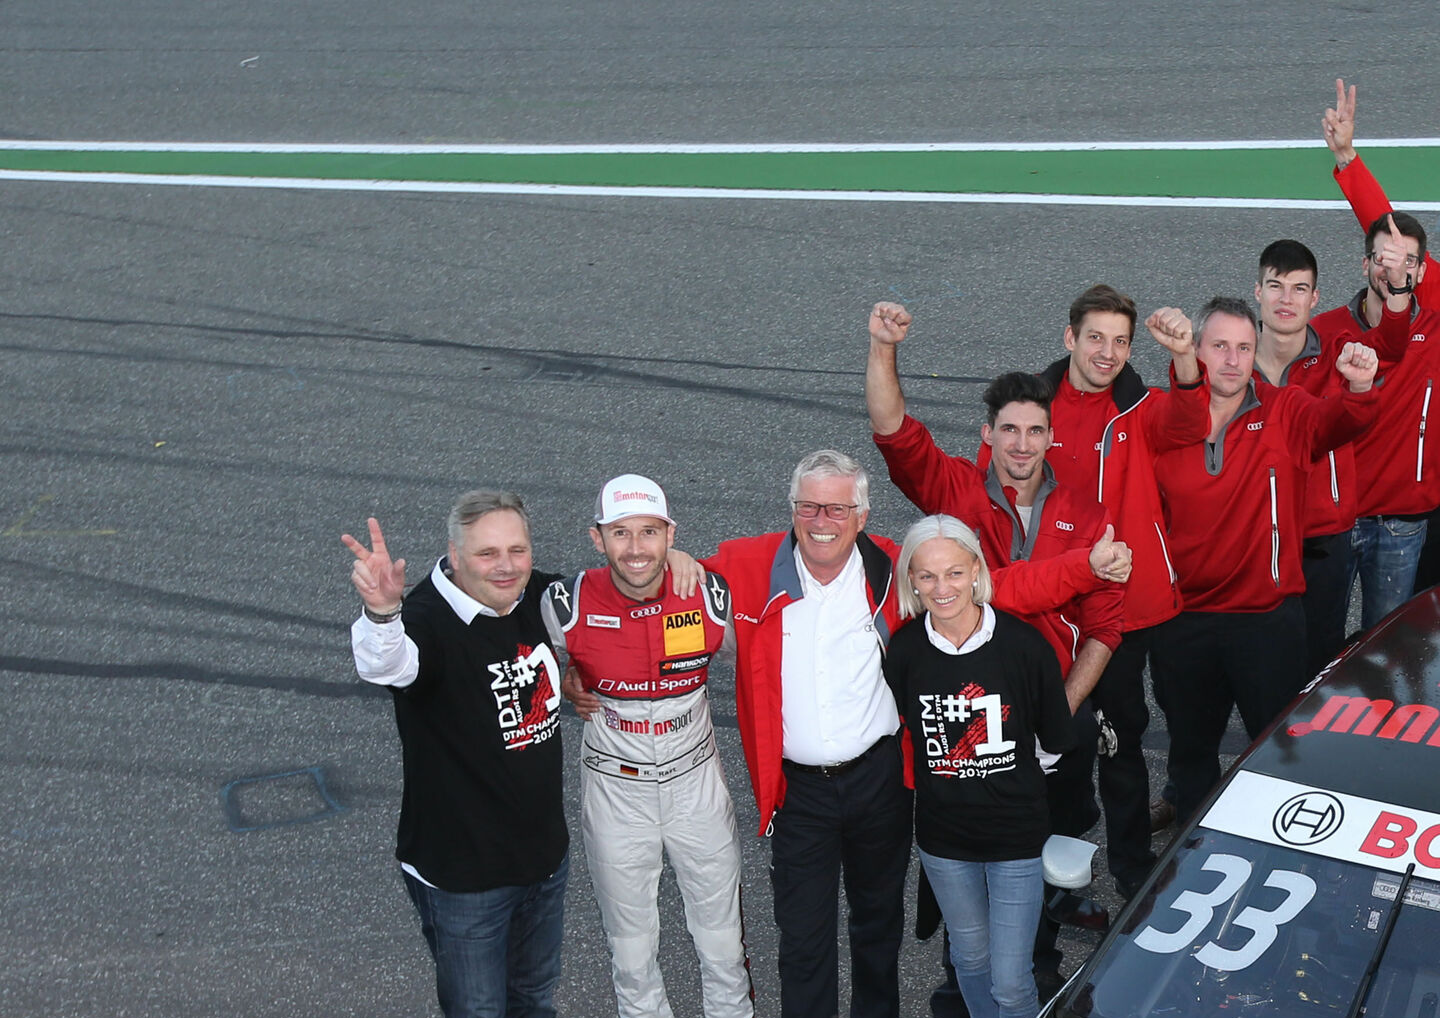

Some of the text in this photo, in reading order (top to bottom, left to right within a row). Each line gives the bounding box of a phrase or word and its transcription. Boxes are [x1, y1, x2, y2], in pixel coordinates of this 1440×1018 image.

[666, 611, 701, 630] ADAC
[487, 662, 518, 729] DTM
[616, 675, 700, 691] Audi Sport
[919, 694, 943, 757] DTM
[941, 693, 1016, 757] #1
[927, 752, 1016, 768] DTM CHAMPIONS
[958, 768, 988, 779] 2017
[1133, 853, 1318, 972] 33
